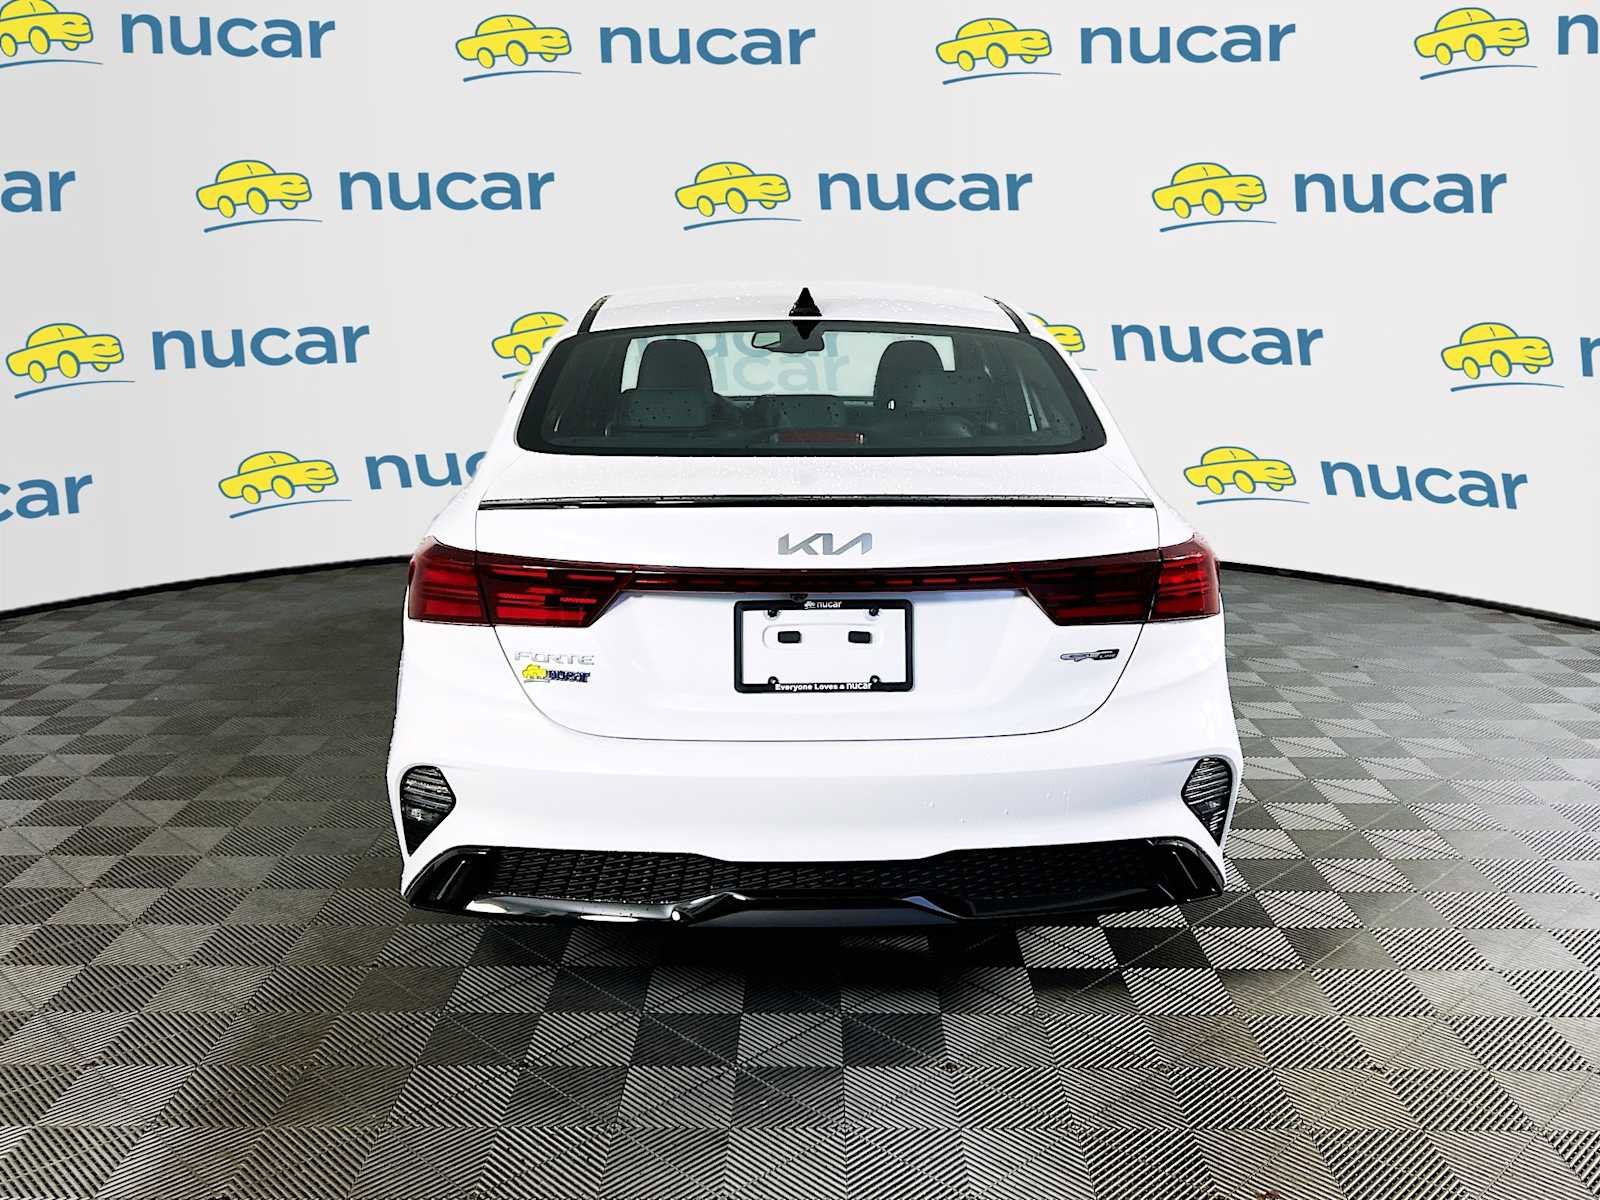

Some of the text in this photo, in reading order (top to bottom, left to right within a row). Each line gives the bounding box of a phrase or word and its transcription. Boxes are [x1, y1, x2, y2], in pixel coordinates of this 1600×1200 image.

[121, 14, 336, 59] nucar
[599, 27, 816, 66] nucar
[1080, 23, 1296, 65] nucar
[338, 171, 555, 211] nucar
[818, 172, 1033, 212] nucar
[1294, 173, 1507, 214] nucar
[151, 324, 369, 370] nucar
[1111, 324, 1324, 366] nucar
[1321, 461, 1528, 510] nucar
[778, 533, 873, 556] KIA
[816, 600, 842, 609] nucar
[774, 683, 813, 692] Everyone
[846, 682, 873, 690] nucar
